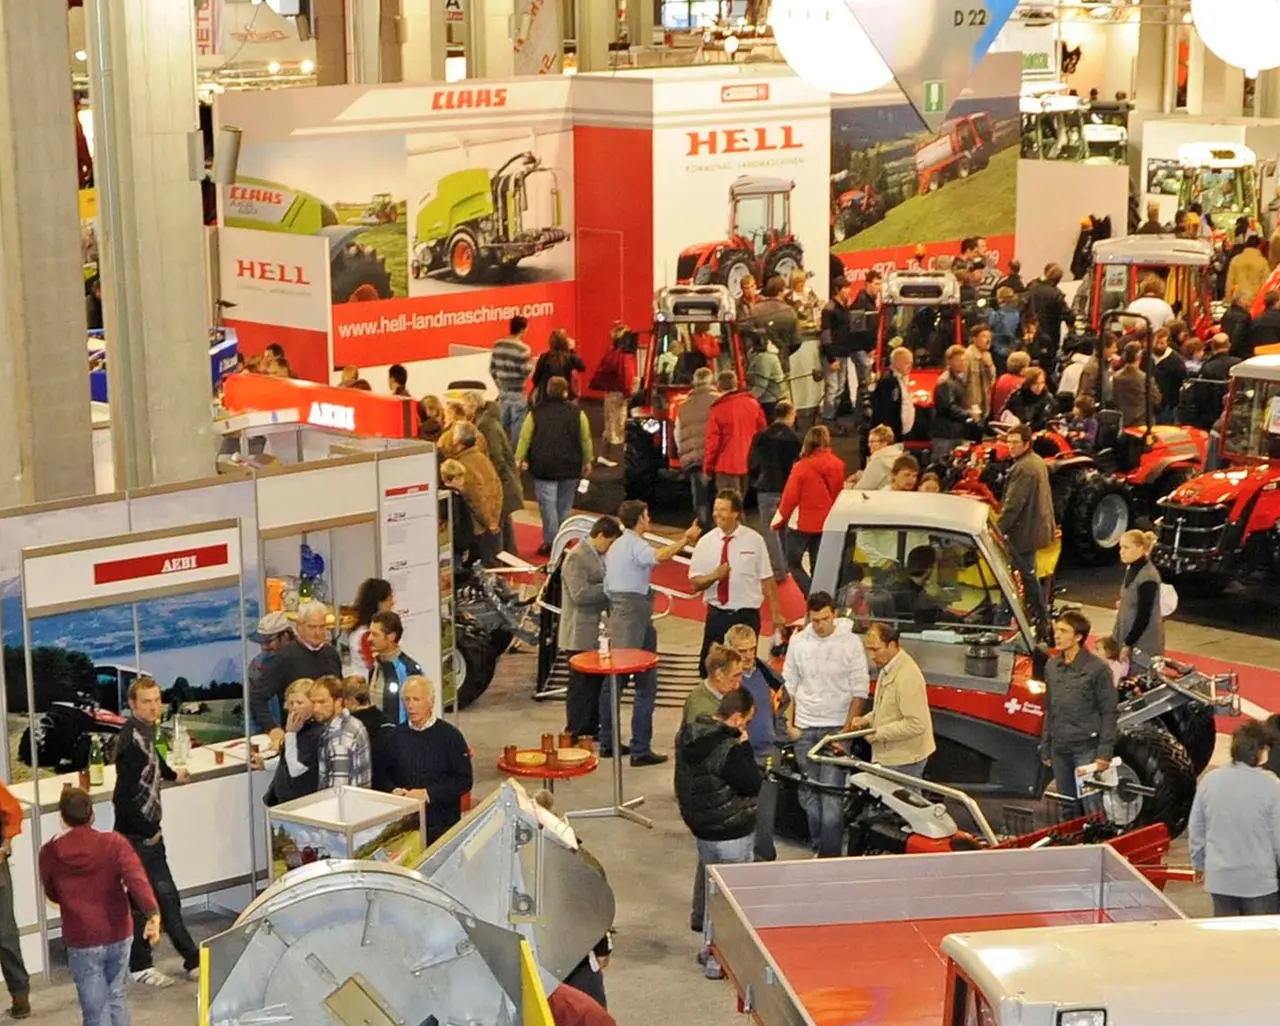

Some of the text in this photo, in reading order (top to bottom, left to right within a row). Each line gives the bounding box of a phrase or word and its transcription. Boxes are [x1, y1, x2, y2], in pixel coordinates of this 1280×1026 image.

[953, 8, 987, 27] D 22
[431, 88, 508, 110] CLAAS
[685, 125, 804, 157] HELL
[229, 185, 283, 205] CLAAS
[236, 259, 311, 285] HELL
[338, 301, 554, 339] www.hell-landmaschinen.com
[161, 555, 198, 573] AEBI
